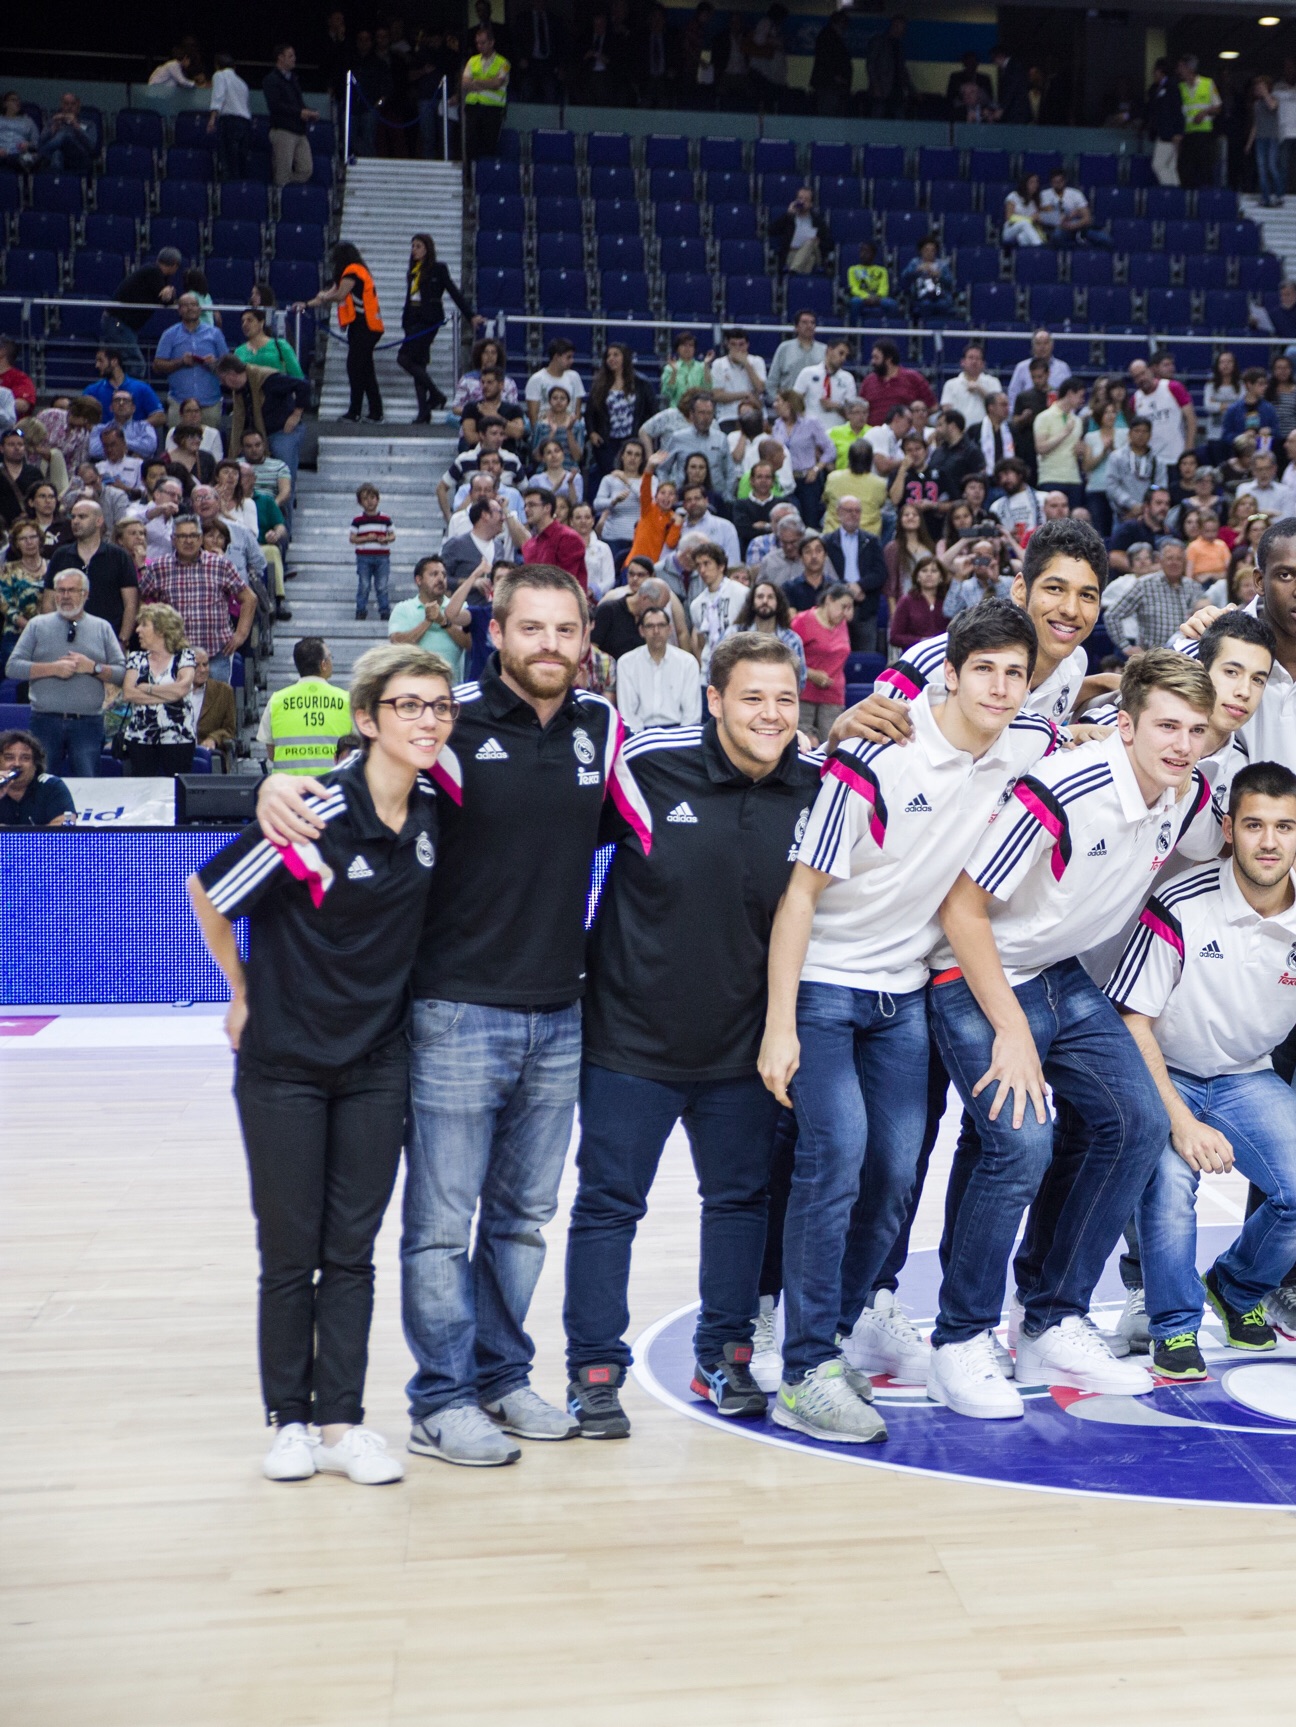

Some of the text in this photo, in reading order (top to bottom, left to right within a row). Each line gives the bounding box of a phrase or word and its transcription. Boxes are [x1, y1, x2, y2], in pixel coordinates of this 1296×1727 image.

[283, 696, 344, 711] SEGURIDAD
[303, 712, 325, 727] 159
[285, 746, 338, 756] PROSEGU
[475, 752, 509, 760] adidas
[577, 766, 600, 786] Teka
[905, 805, 932, 813] adidas
[76, 807, 124, 822] id
[667, 814, 698, 823] adidas
[1087, 849, 1107, 857] adidas
[1199, 951, 1224, 960] adidas
